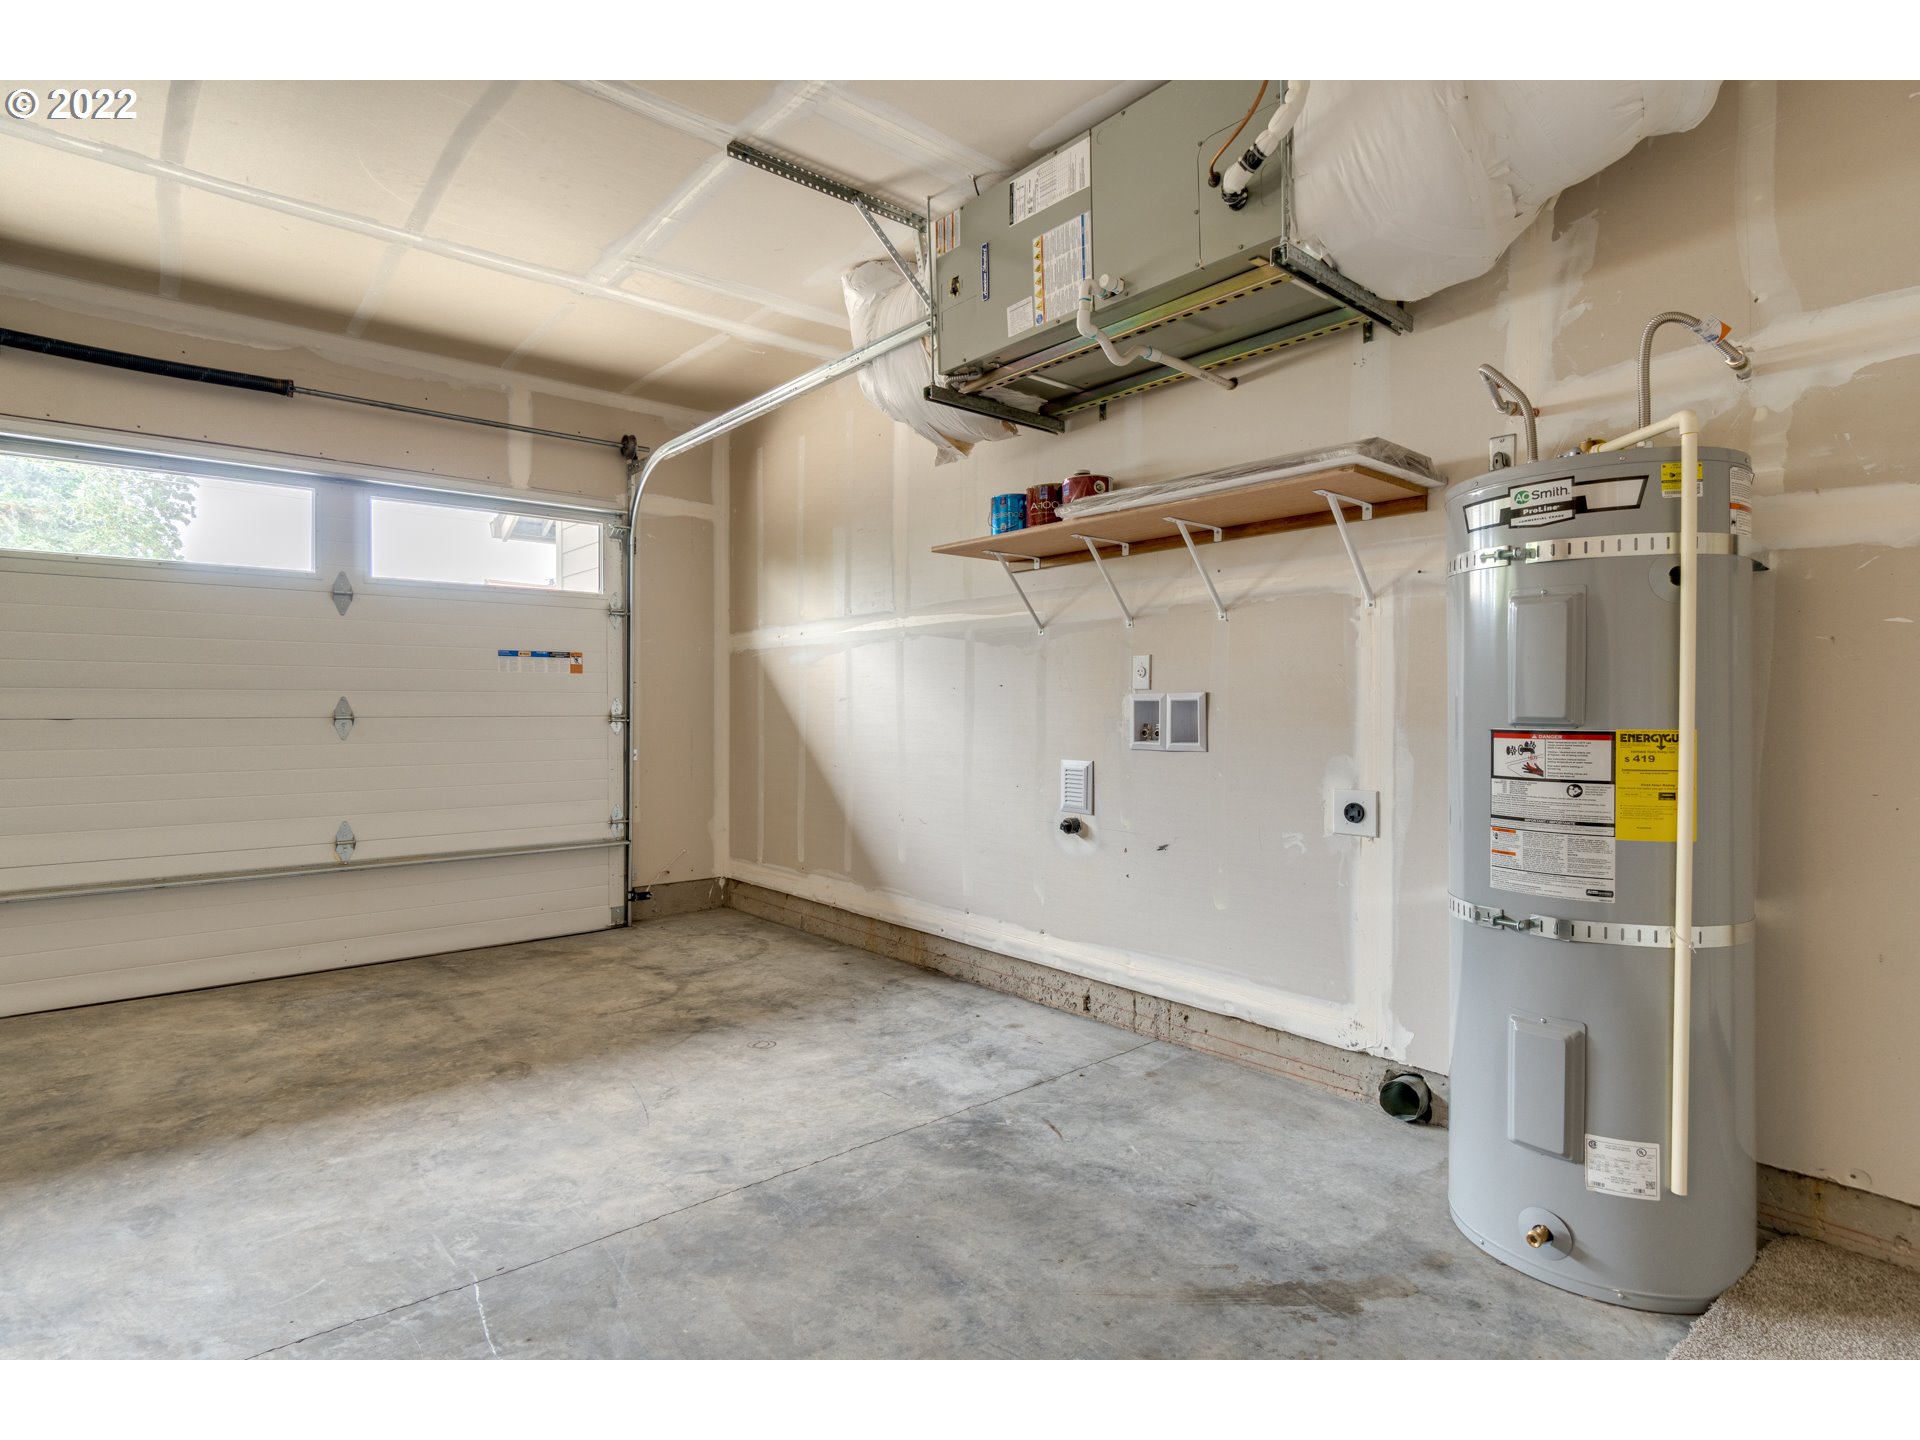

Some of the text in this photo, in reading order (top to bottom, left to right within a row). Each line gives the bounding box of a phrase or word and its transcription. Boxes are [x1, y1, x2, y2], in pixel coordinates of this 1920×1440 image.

[1531, 487, 1568, 500] Smith
[1523, 504, 1559, 515] ProLine
[1619, 732, 1679, 746] ENERGYGU
[1632, 754, 1656, 763] 419
